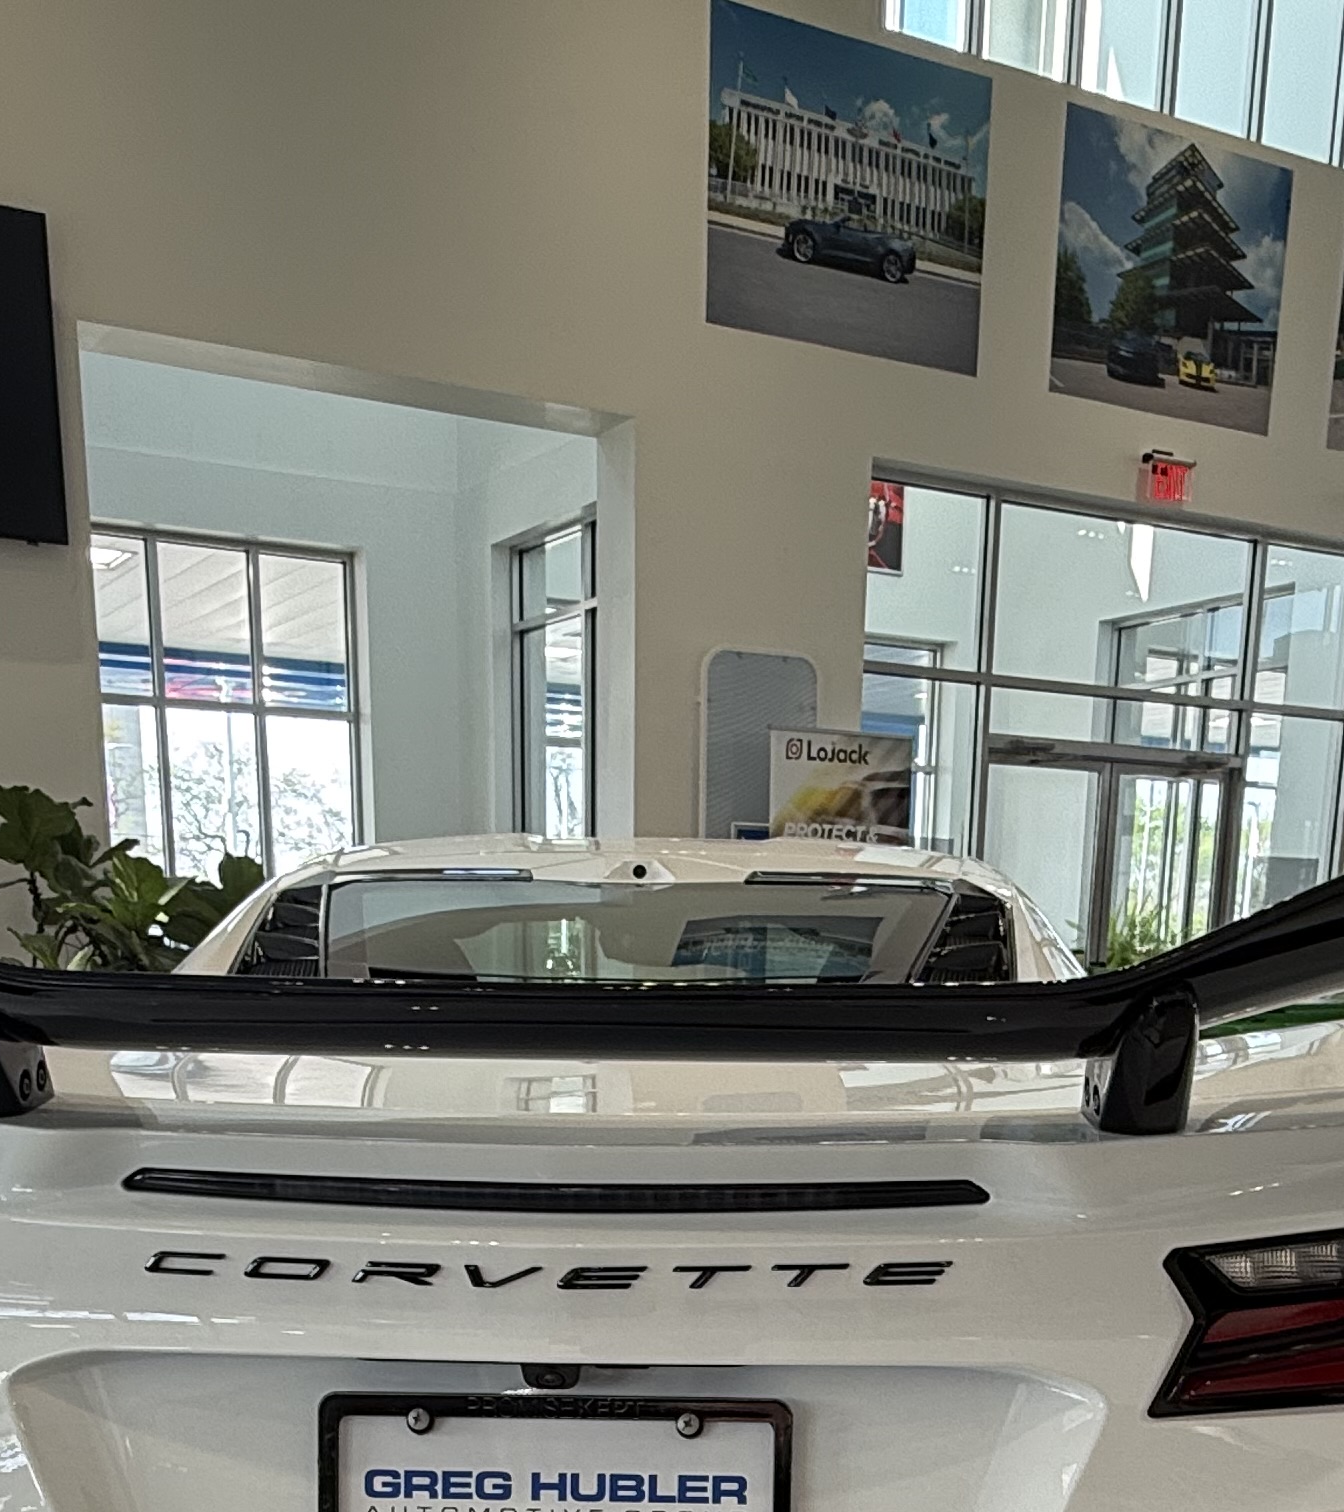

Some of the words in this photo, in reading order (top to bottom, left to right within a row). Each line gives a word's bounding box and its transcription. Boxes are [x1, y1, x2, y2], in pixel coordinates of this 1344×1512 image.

[784, 822, 866, 841] PROTECT
[144, 1250, 954, 1290] CORVETTE
[364, 1469, 512, 1501] GREG
[531, 1472, 748, 1505] HUBLER
